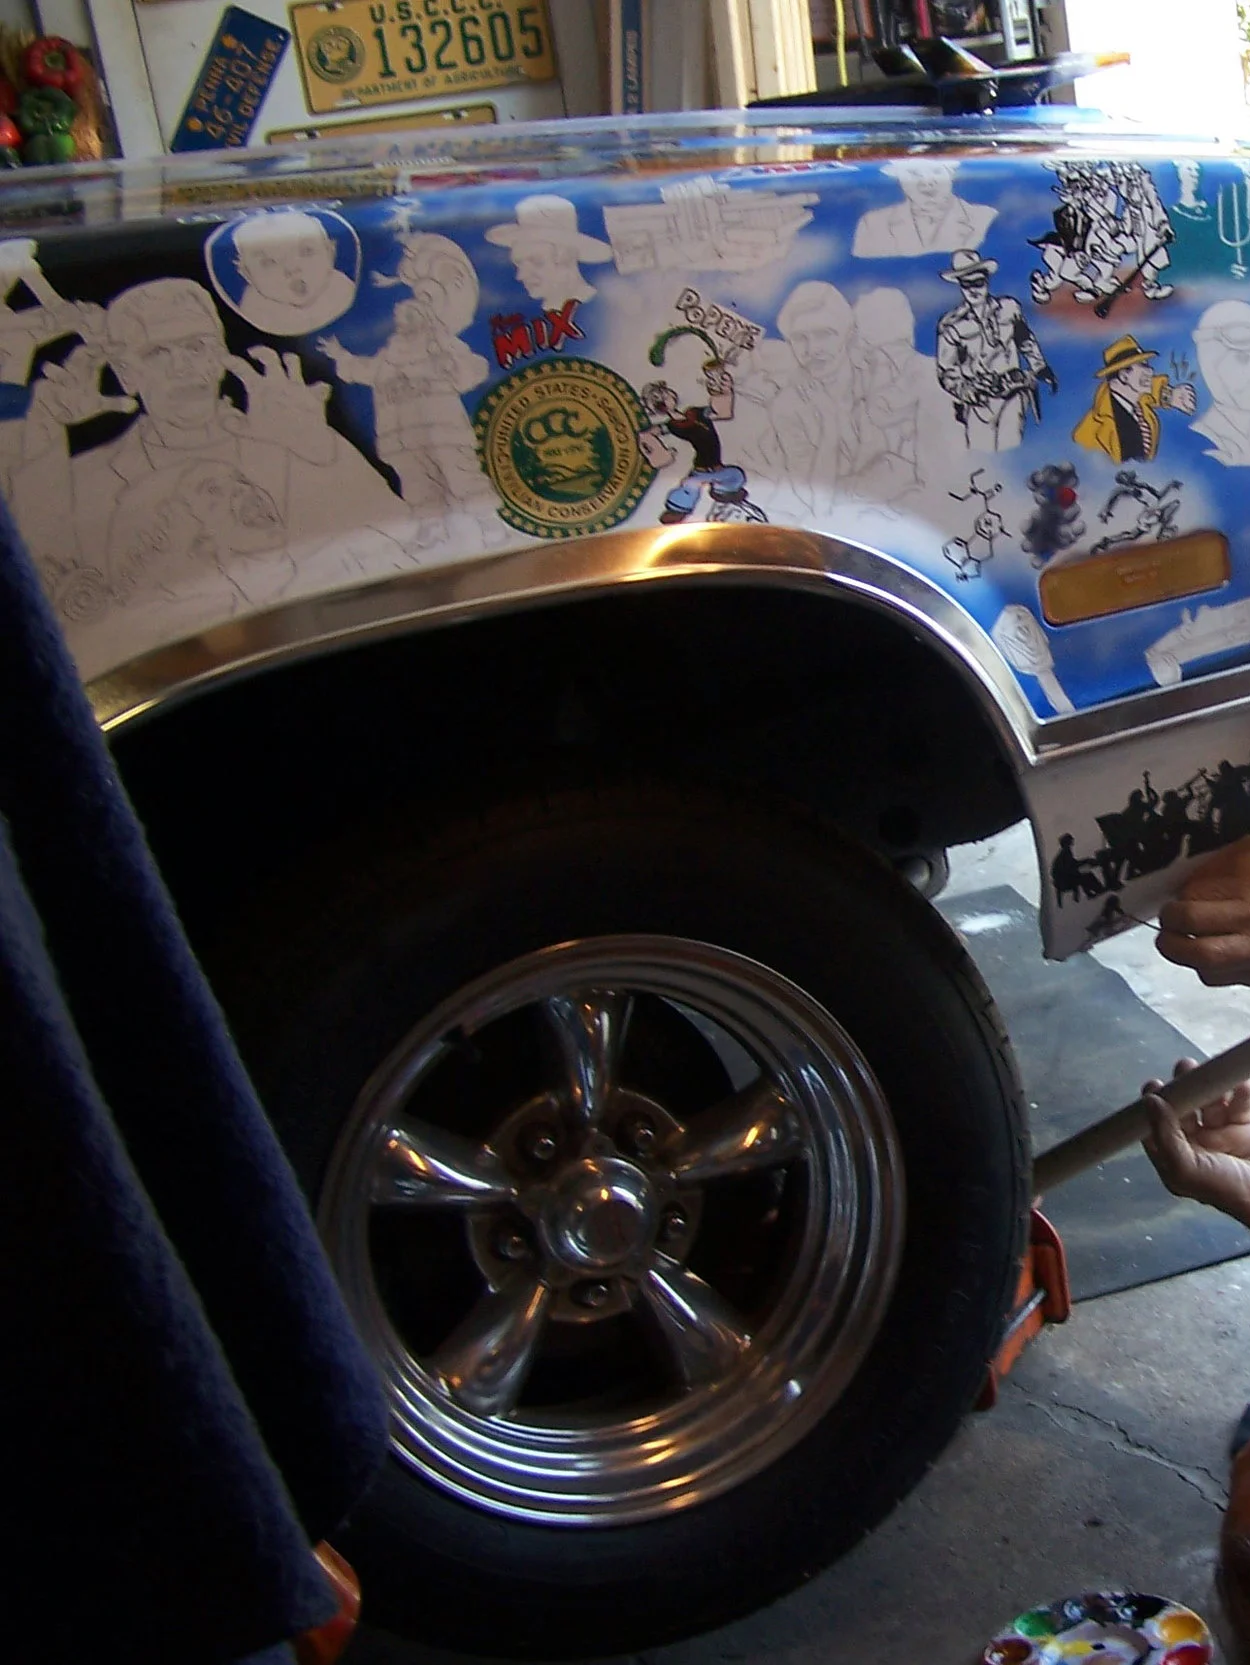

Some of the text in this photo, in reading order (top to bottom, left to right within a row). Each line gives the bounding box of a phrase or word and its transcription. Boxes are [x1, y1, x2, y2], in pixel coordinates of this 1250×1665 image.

[372, 7, 543, 78] 132605
[193, 57, 229, 112] PENNA
[238, 40, 280, 118] DEFENSE
[342, 63, 523, 99] DEPARTMENT OF AGRICULTURE
[494, 298, 586, 370] MIX
[676, 287, 761, 351] POPEYE
[496, 381, 591, 446] UNITED STATES
[522, 407, 581, 445] CCC
[547, 448, 632, 519] CONSERVATION
